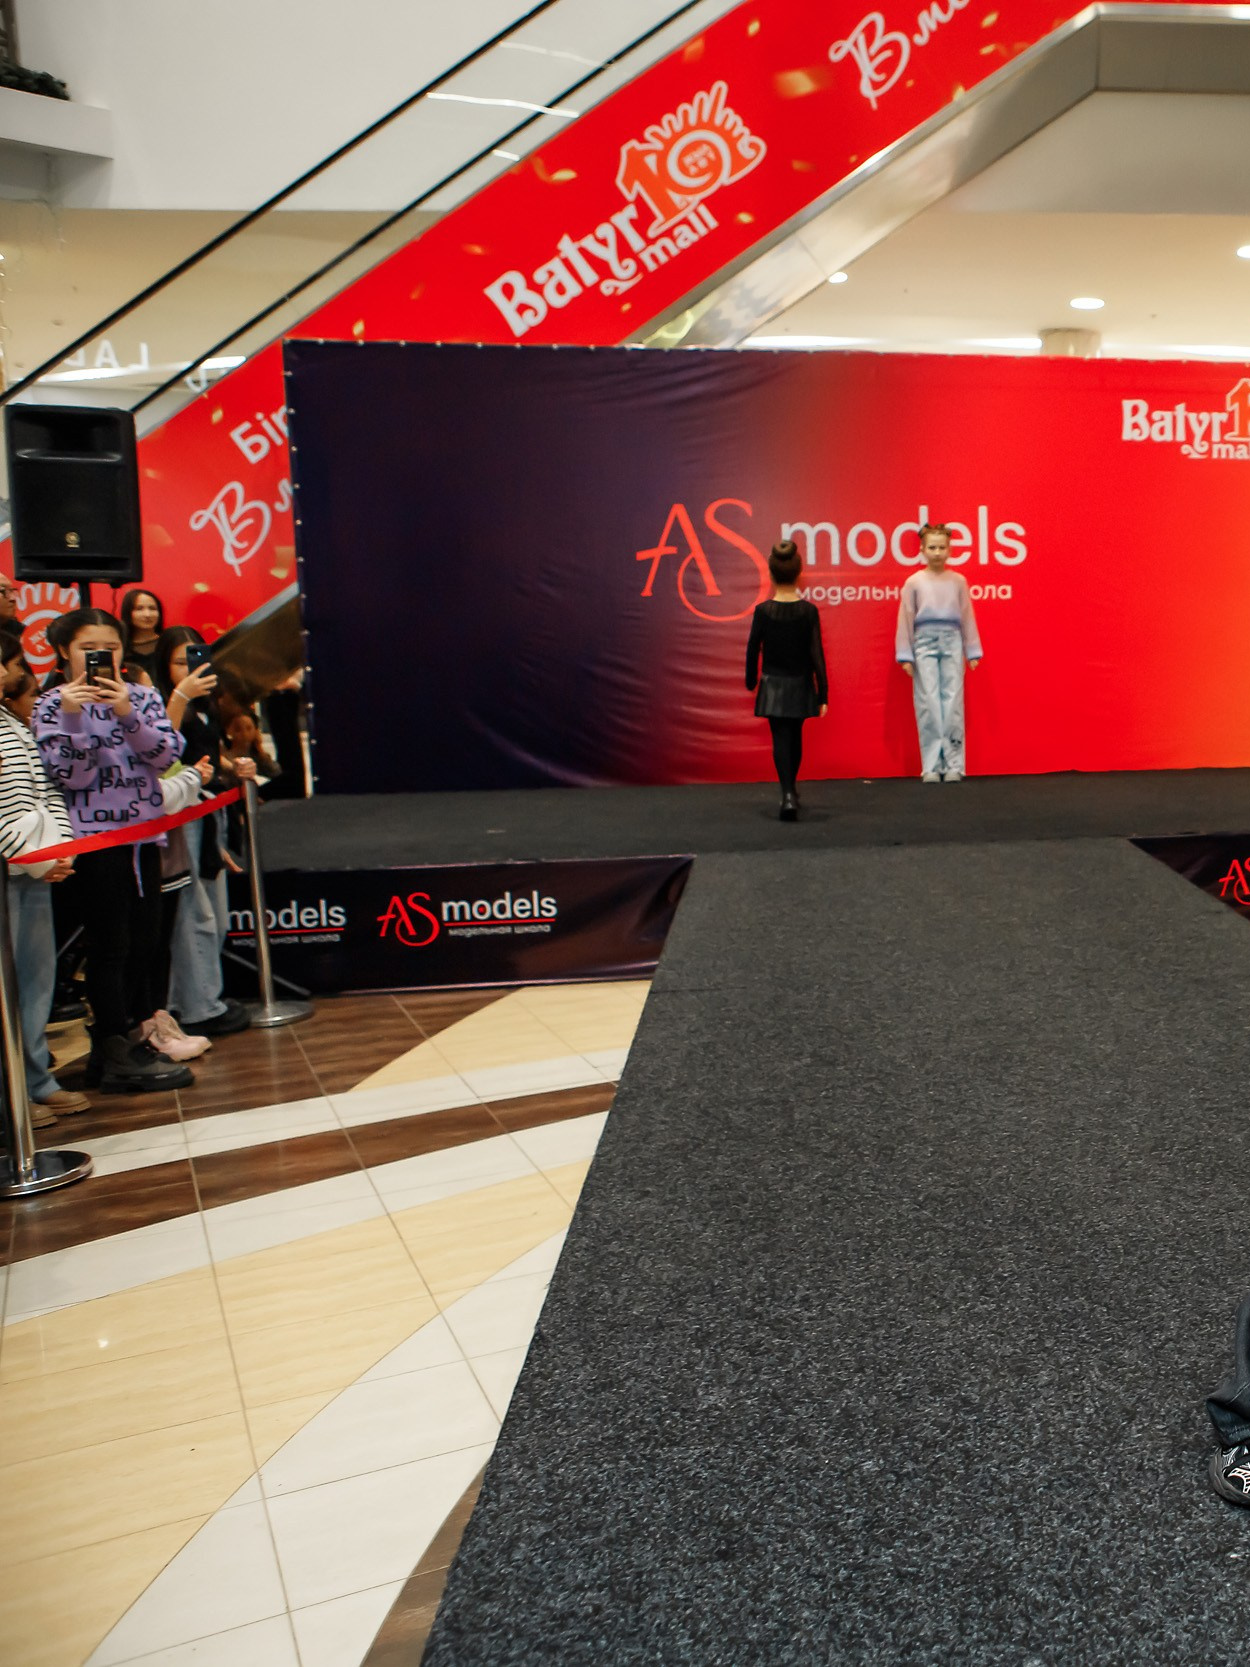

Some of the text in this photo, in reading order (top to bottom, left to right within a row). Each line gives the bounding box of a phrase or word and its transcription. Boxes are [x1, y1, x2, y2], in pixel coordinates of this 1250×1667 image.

[639, 204, 719, 272] mall
[483, 203, 647, 337] Batyr
[1121, 399, 1229, 459] Batyr
[636, 498, 1028, 622] AS models
[796, 585, 900, 605] модельн
[78, 800, 140, 824] LOUIS
[377, 890, 557, 947] AS models
